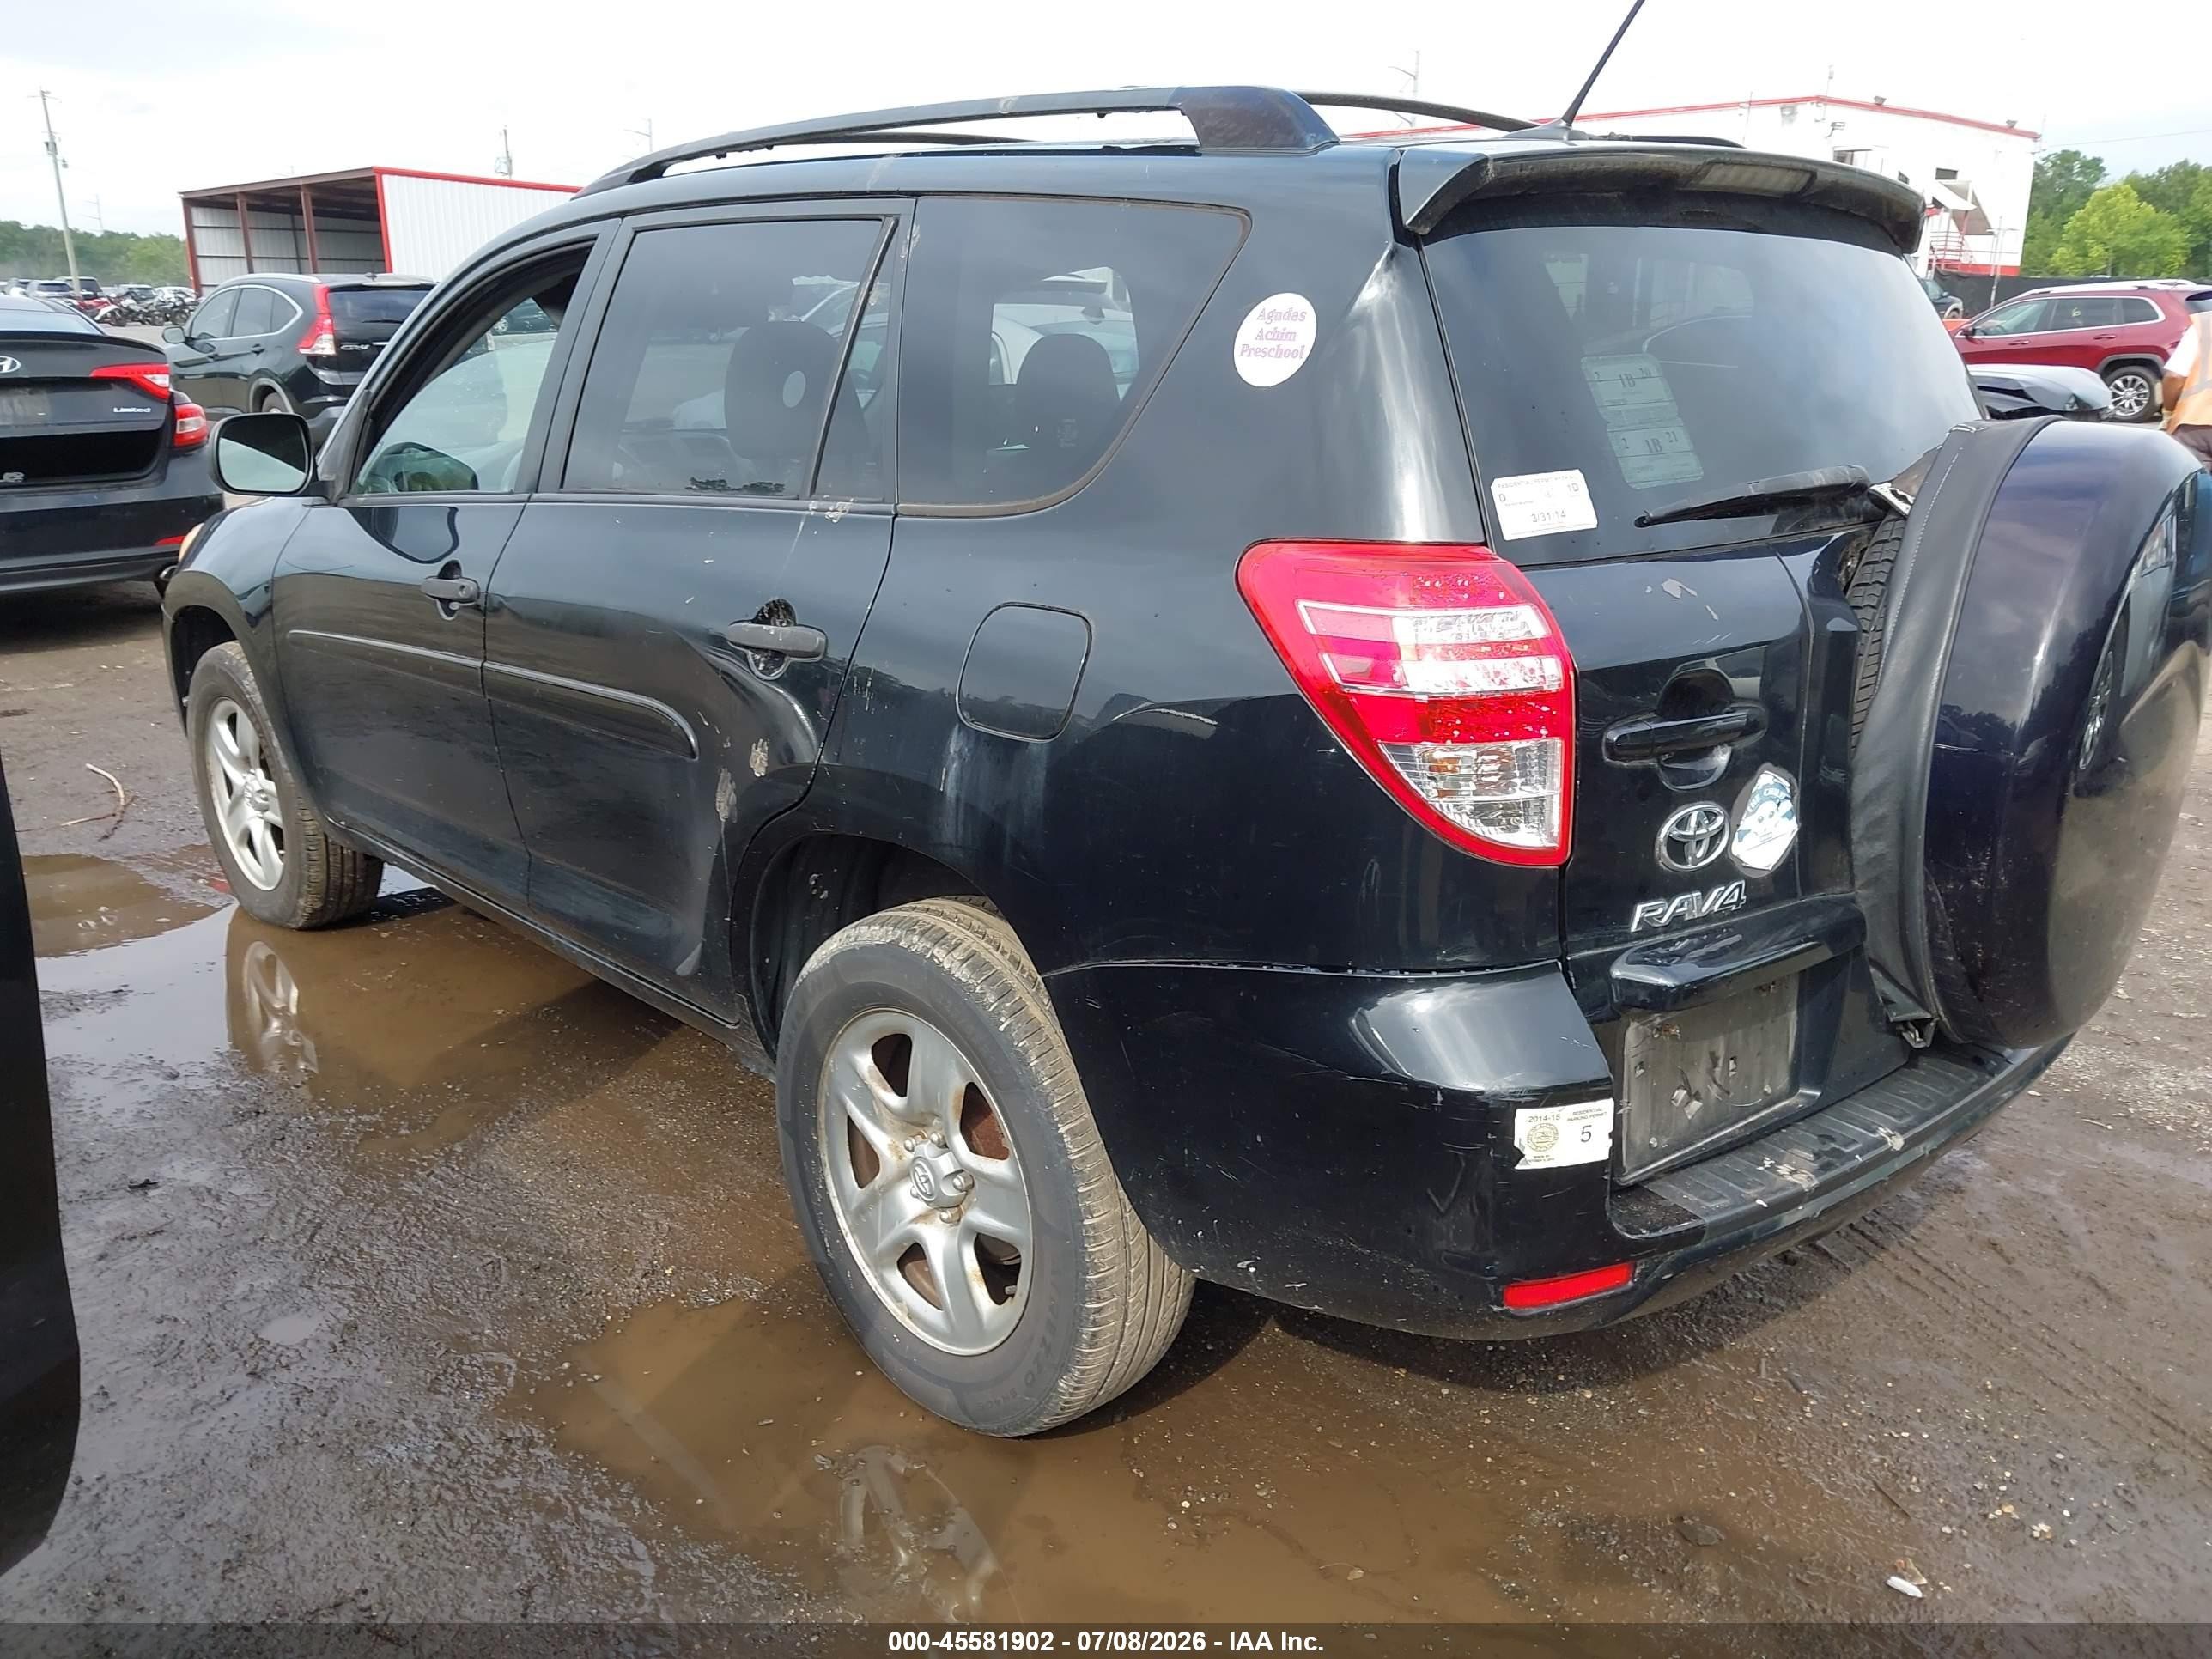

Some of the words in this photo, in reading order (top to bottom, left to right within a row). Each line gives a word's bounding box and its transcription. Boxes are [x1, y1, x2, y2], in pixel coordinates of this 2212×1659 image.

[1256, 307, 1307, 325] Agudas
[1255, 327, 1297, 342] Achim
[1240, 344, 1305, 359] Preschool
[1619, 373, 1636, 388] 1B
[1644, 438, 1663, 453] 1B
[1531, 508, 1566, 523] 3/31/14
[1631, 880, 1747, 932] RAV4
[1528, 1114, 1560, 1123] 2014-15
[1581, 1125, 1592, 1143] 5
